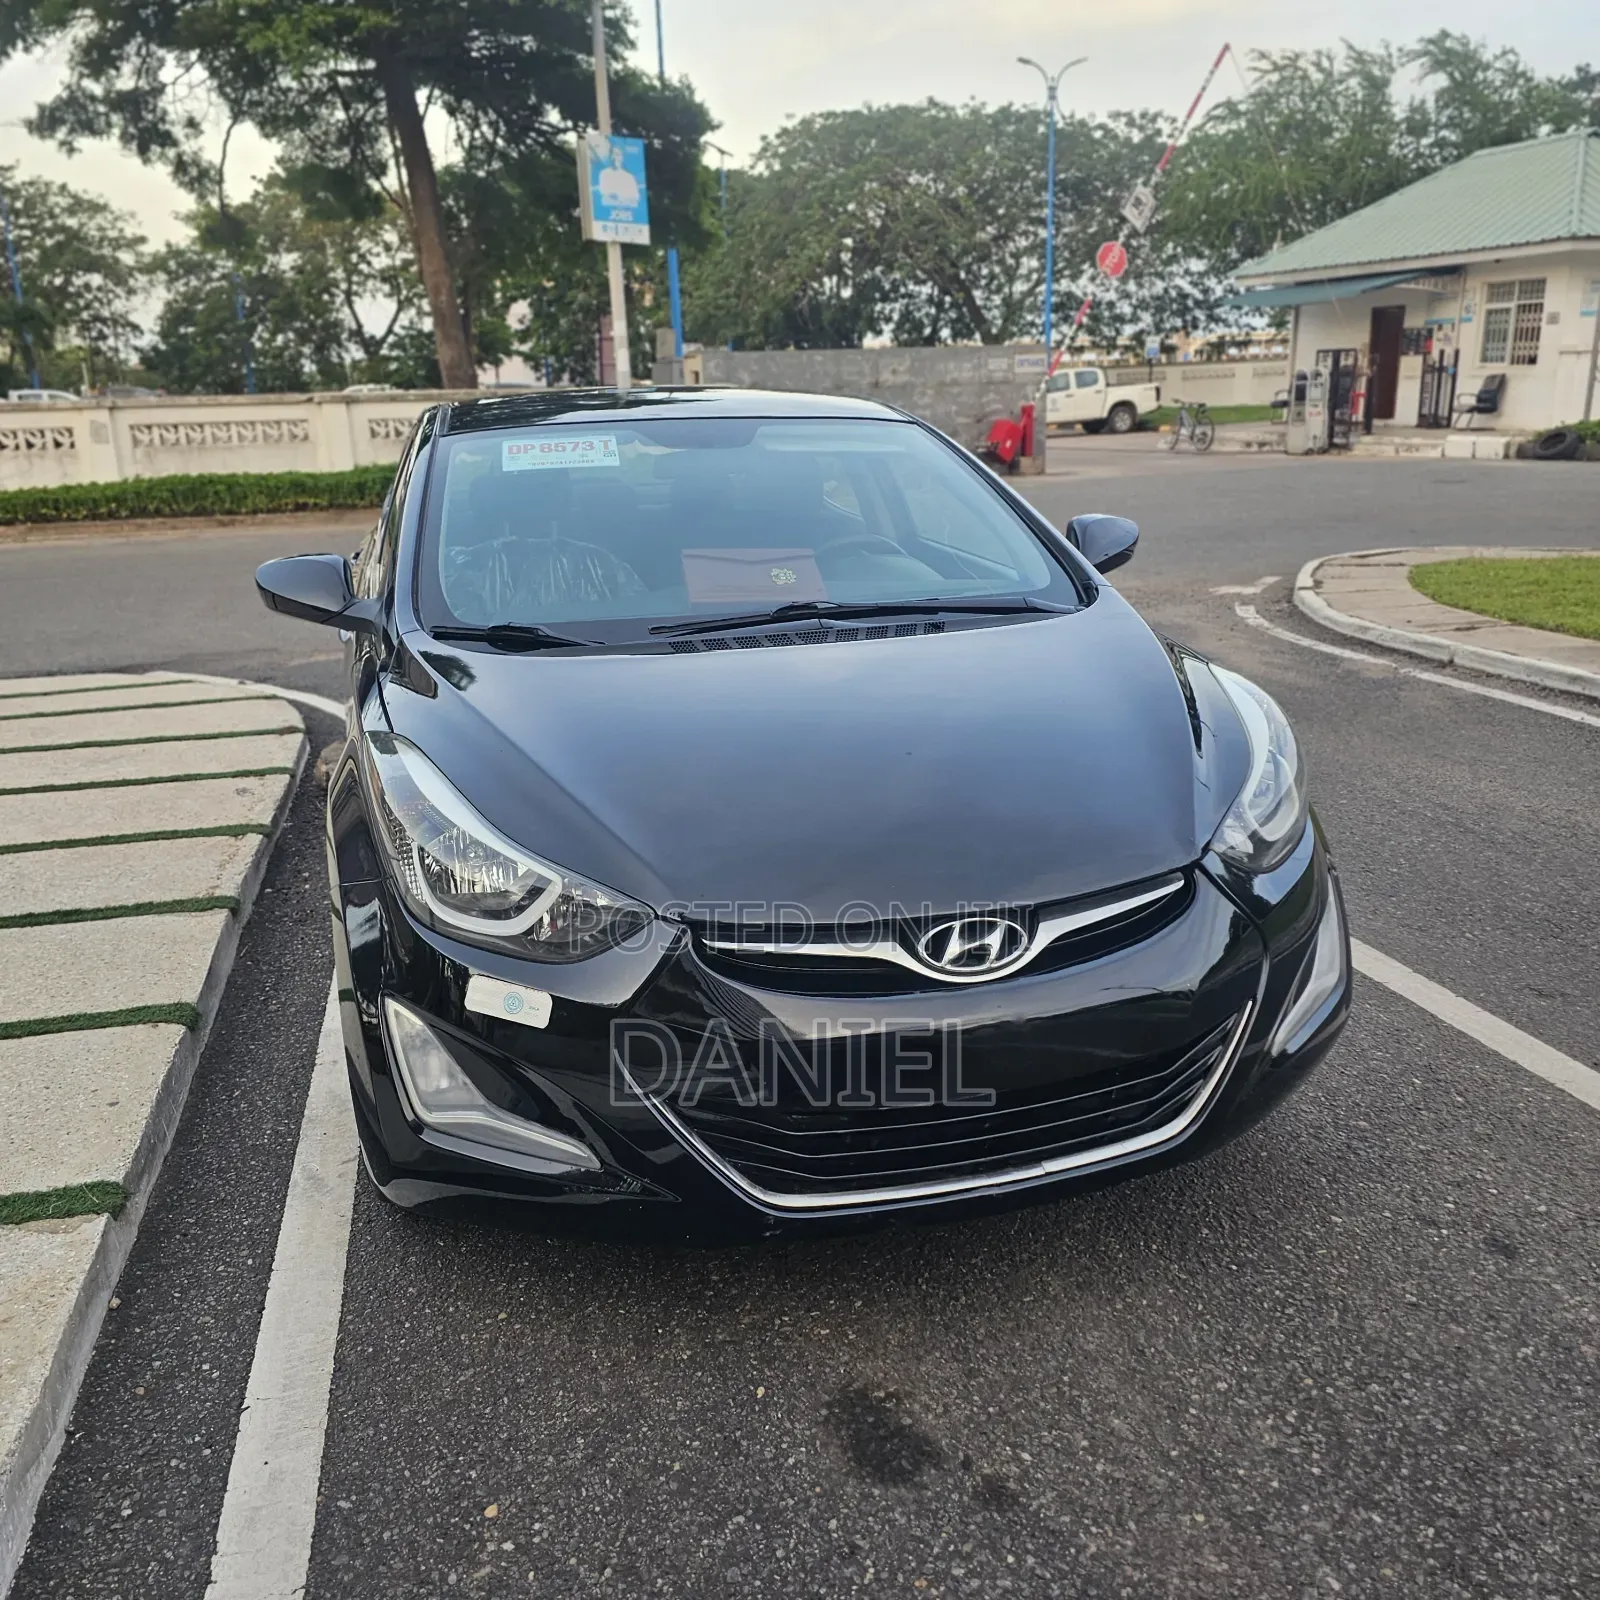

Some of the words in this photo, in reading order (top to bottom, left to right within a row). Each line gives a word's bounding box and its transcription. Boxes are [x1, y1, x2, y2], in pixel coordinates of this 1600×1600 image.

[507, 443, 536, 455] DP
[540, 441, 595, 454] 8573
[599, 439, 612, 451] T
